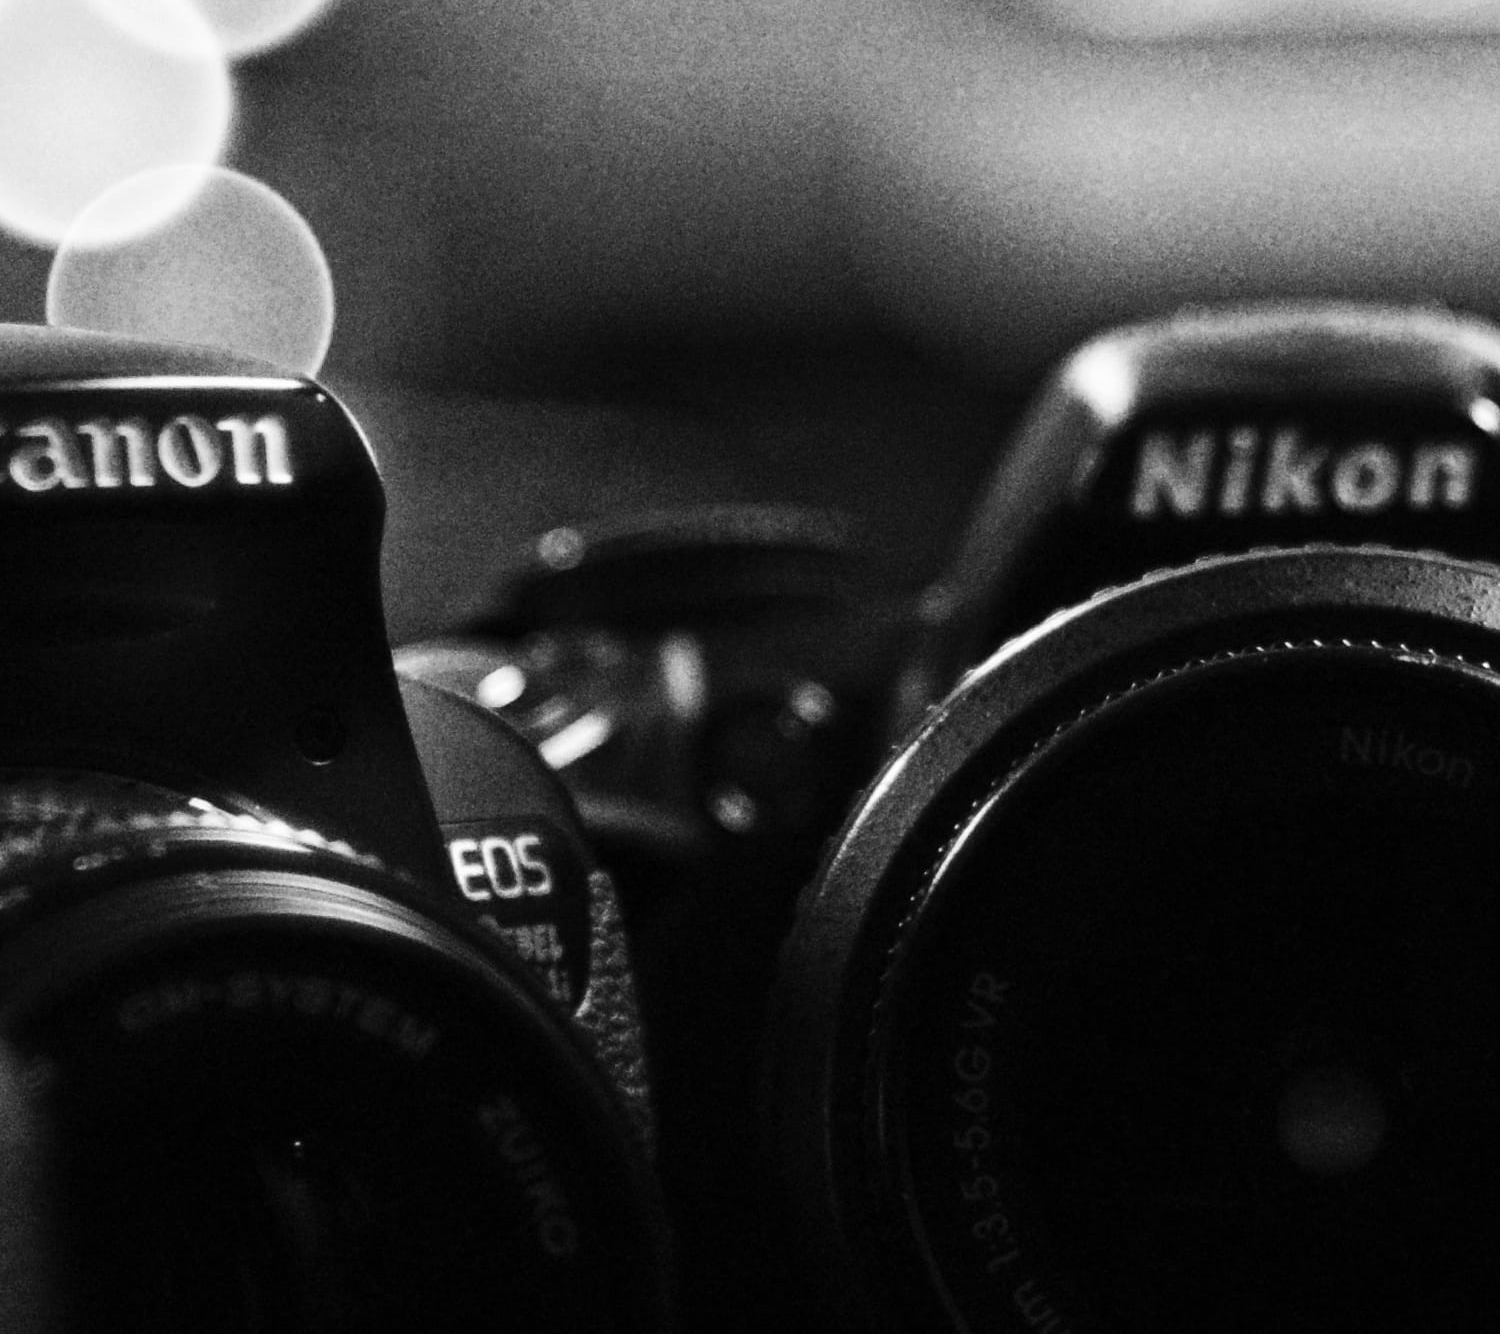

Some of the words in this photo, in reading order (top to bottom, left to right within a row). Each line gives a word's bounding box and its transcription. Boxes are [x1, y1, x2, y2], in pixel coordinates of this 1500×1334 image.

[1133, 426, 1480, 517] Nikon
[1337, 725, 1477, 789] Nikon
[447, 834, 554, 902] EOS
[960, 971, 1011, 1029] VR
[475, 1094, 580, 1259] ZUIKO
[951, 1047, 1019, 1275] 1:3.5-5.6G
